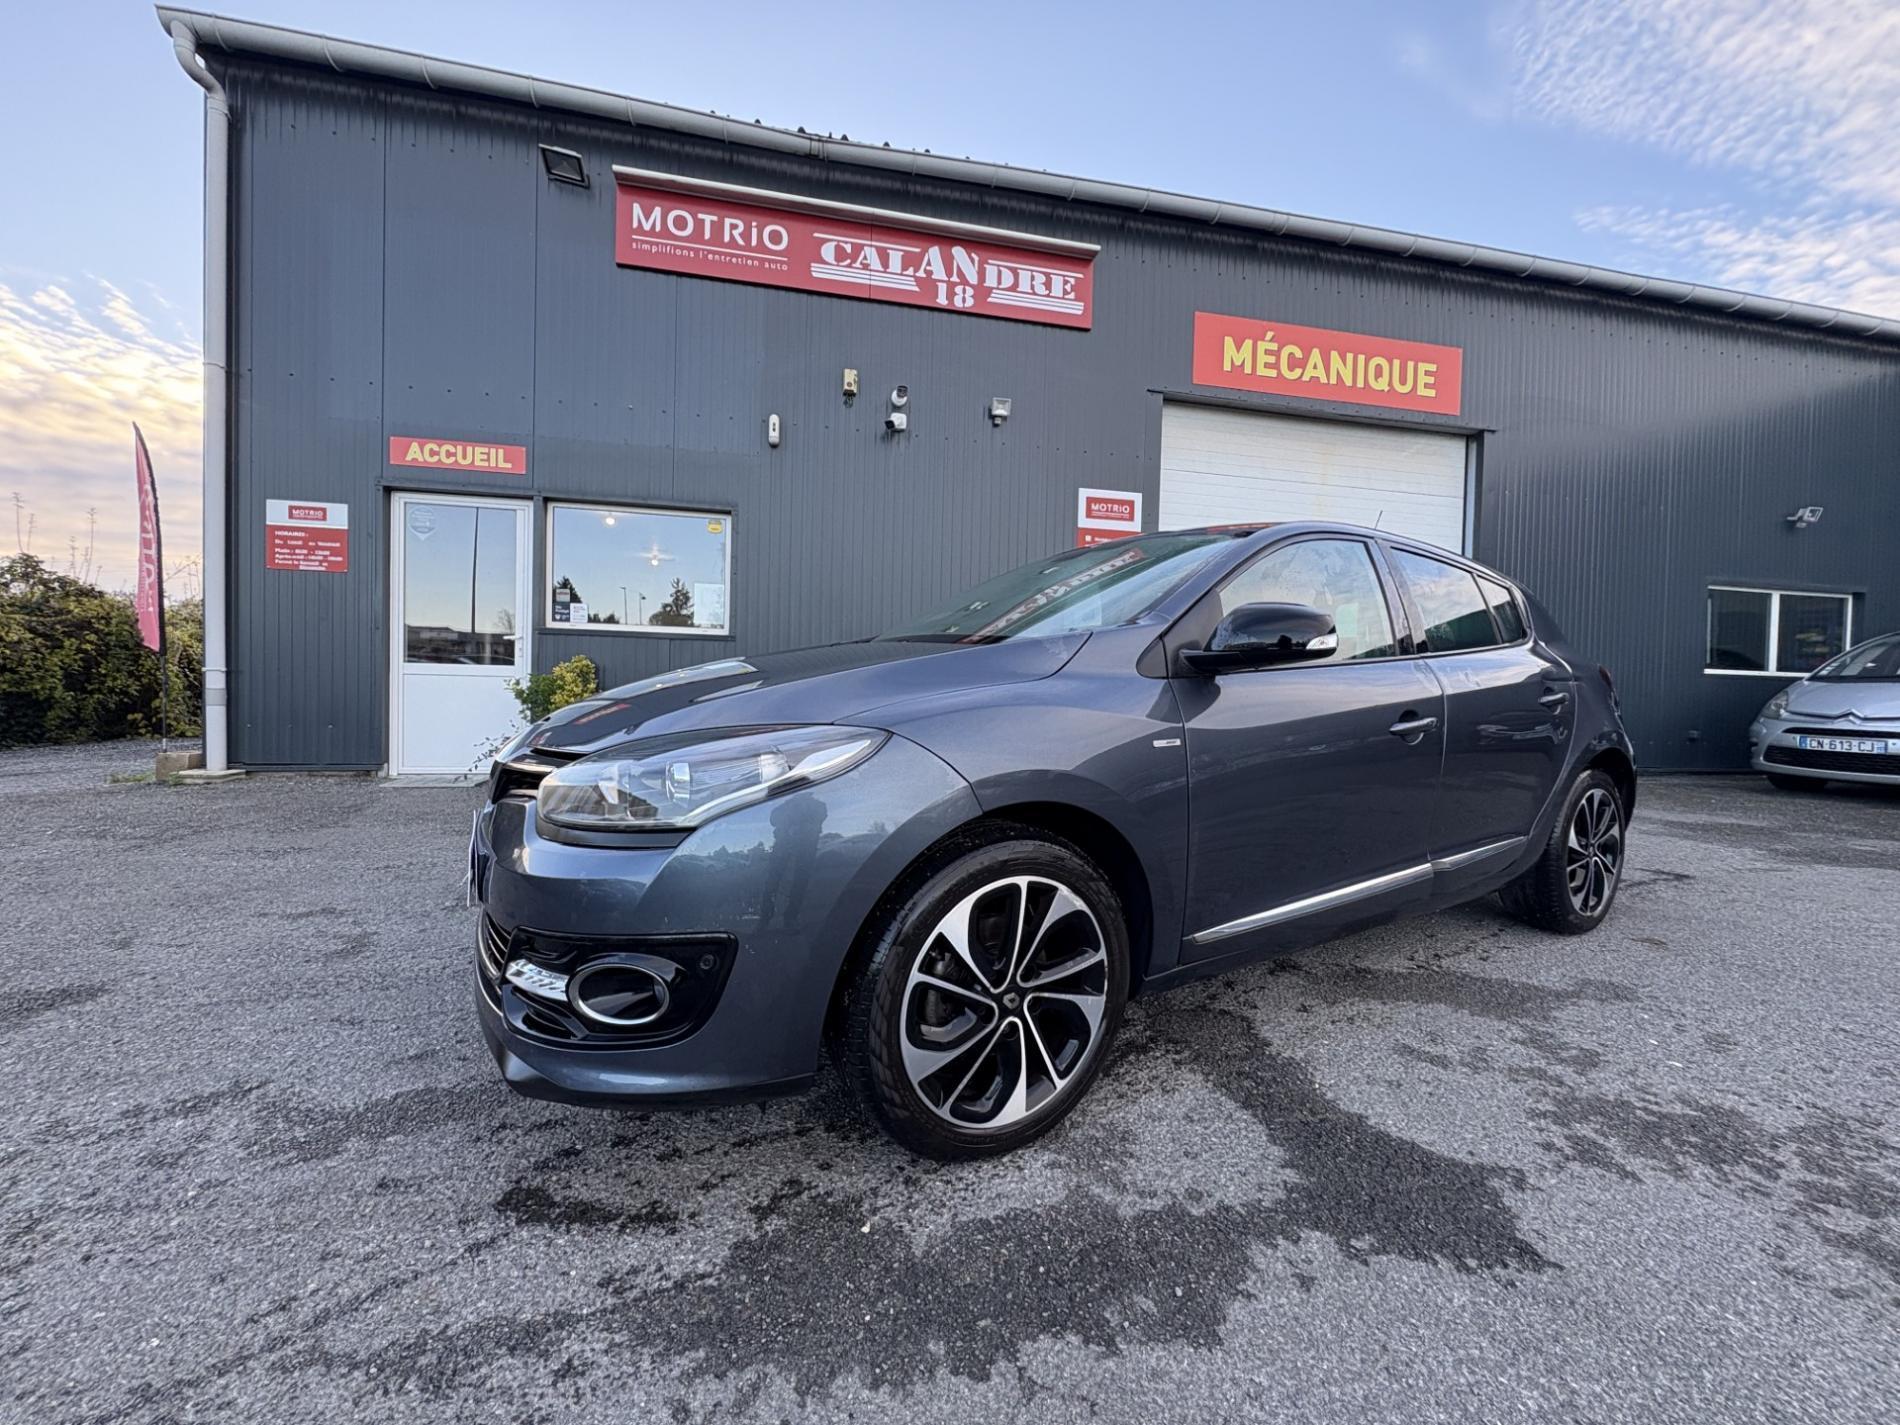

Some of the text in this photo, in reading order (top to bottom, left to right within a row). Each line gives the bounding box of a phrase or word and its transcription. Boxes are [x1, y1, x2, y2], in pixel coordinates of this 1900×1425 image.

[632, 241, 788, 271] simplifions l'entretien auto
[820, 240, 1076, 300] CALANDRE
[936, 282, 975, 308] 18
[1223, 331, 1438, 398] MÉCANIQUE
[405, 441, 513, 468] ACCUEIL
